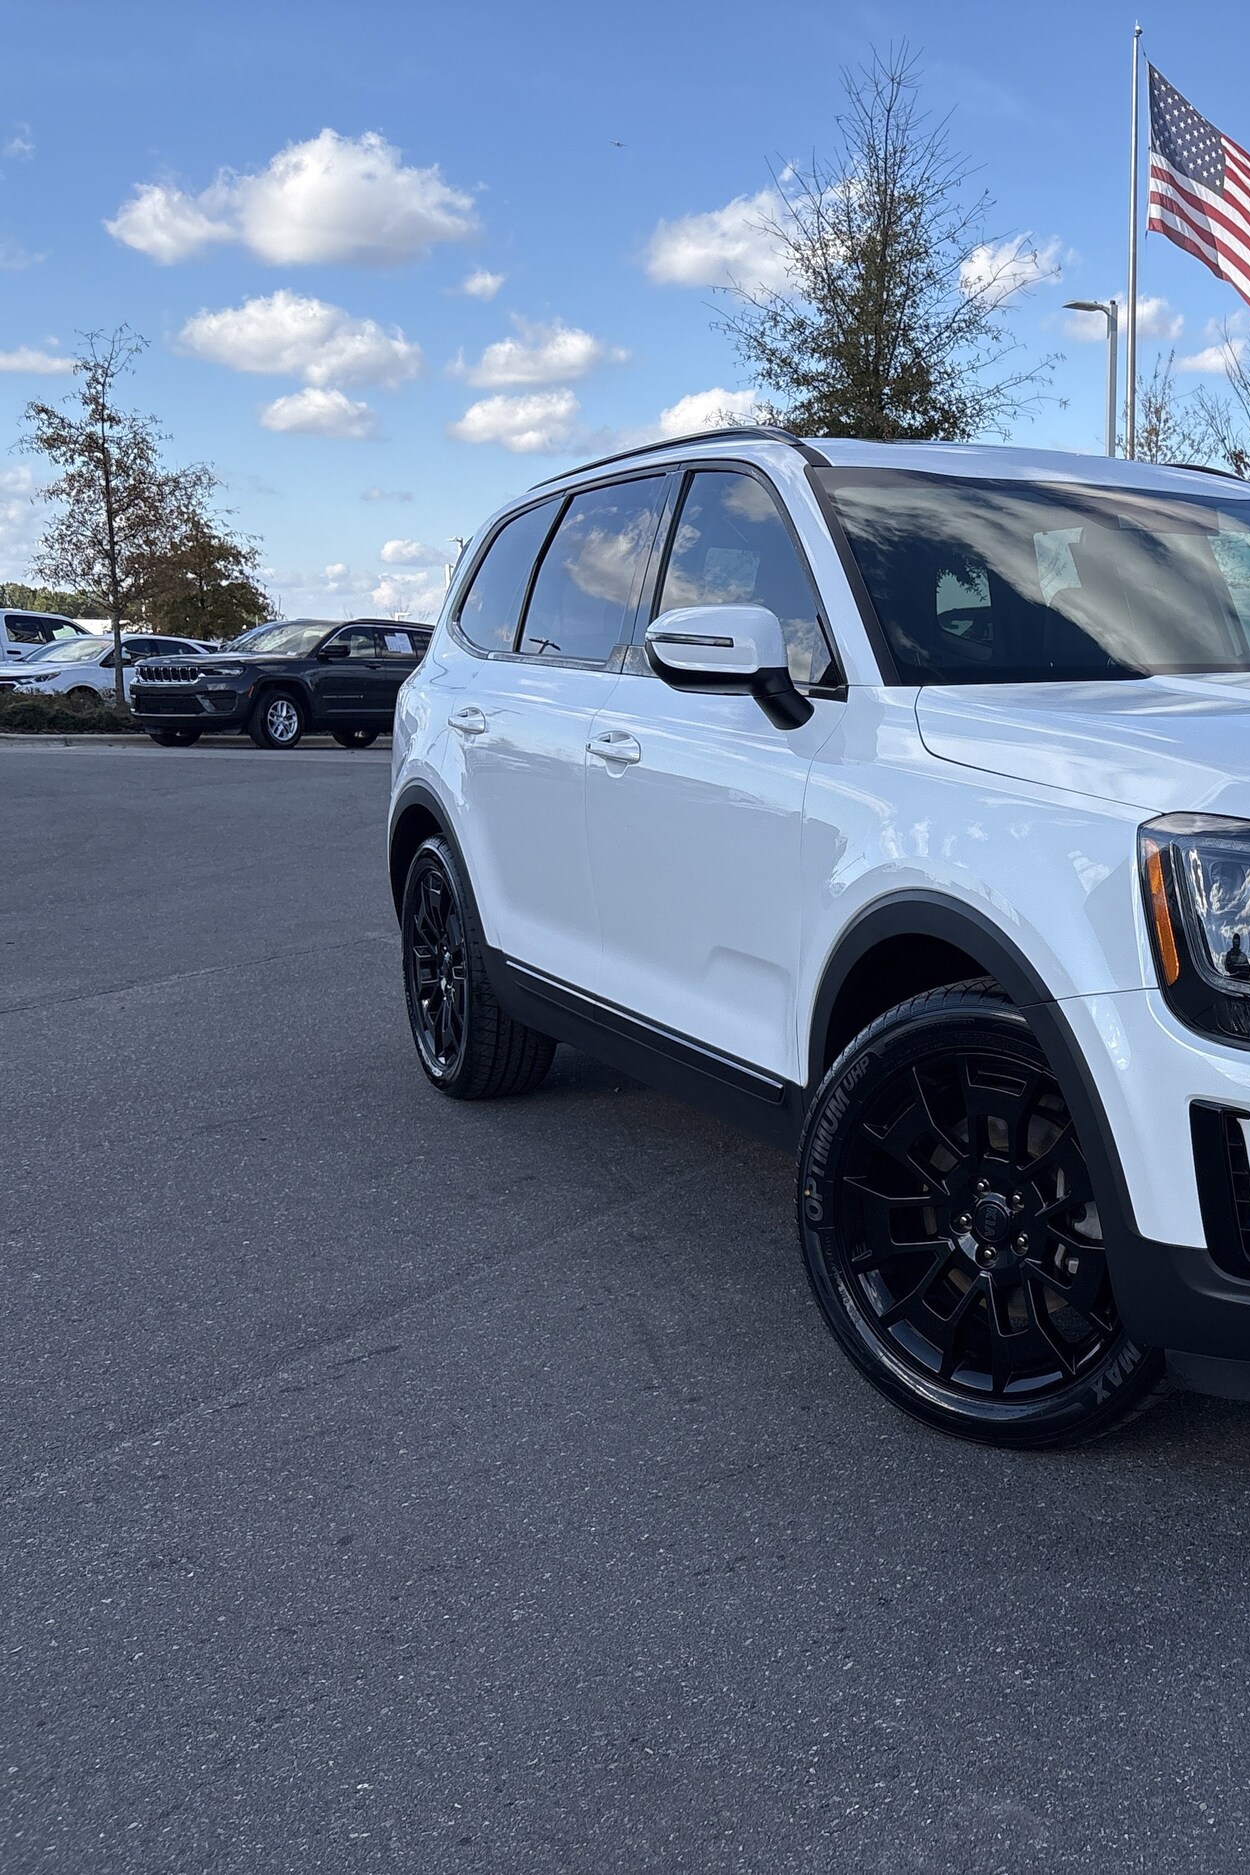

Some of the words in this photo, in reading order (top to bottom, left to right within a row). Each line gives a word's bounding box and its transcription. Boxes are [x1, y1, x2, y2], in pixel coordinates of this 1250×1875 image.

[805, 1086, 850, 1222] OPTIMUM
[843, 1056, 870, 1091] UHP
[984, 1207, 998, 1237] KIA
